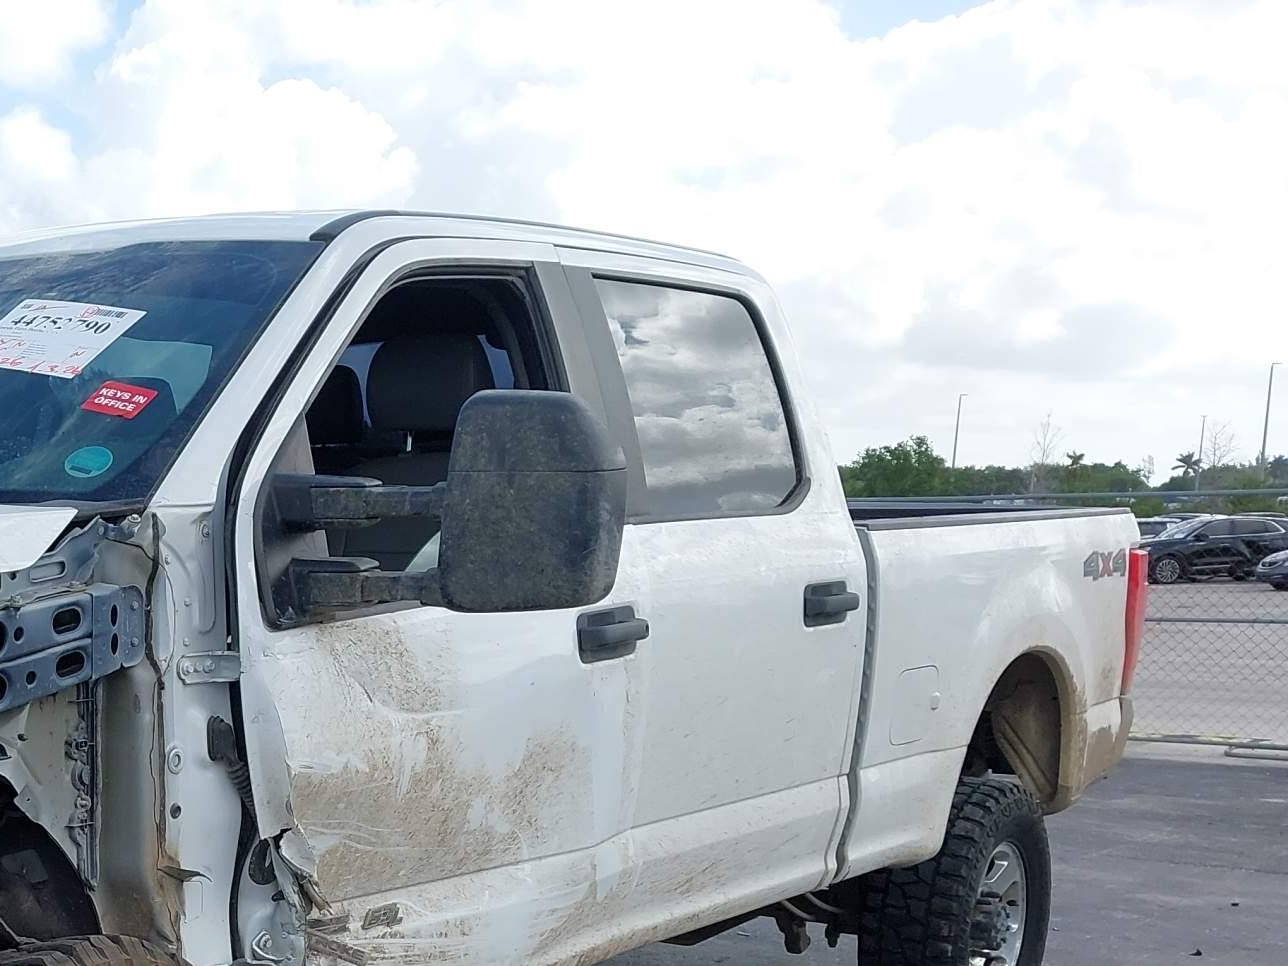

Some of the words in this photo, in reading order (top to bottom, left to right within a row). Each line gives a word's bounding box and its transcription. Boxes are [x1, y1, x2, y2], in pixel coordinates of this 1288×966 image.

[94, 396, 137, 411] OFFICE
[99, 388, 131, 399] KEYS
[132, 395, 148, 404] IN
